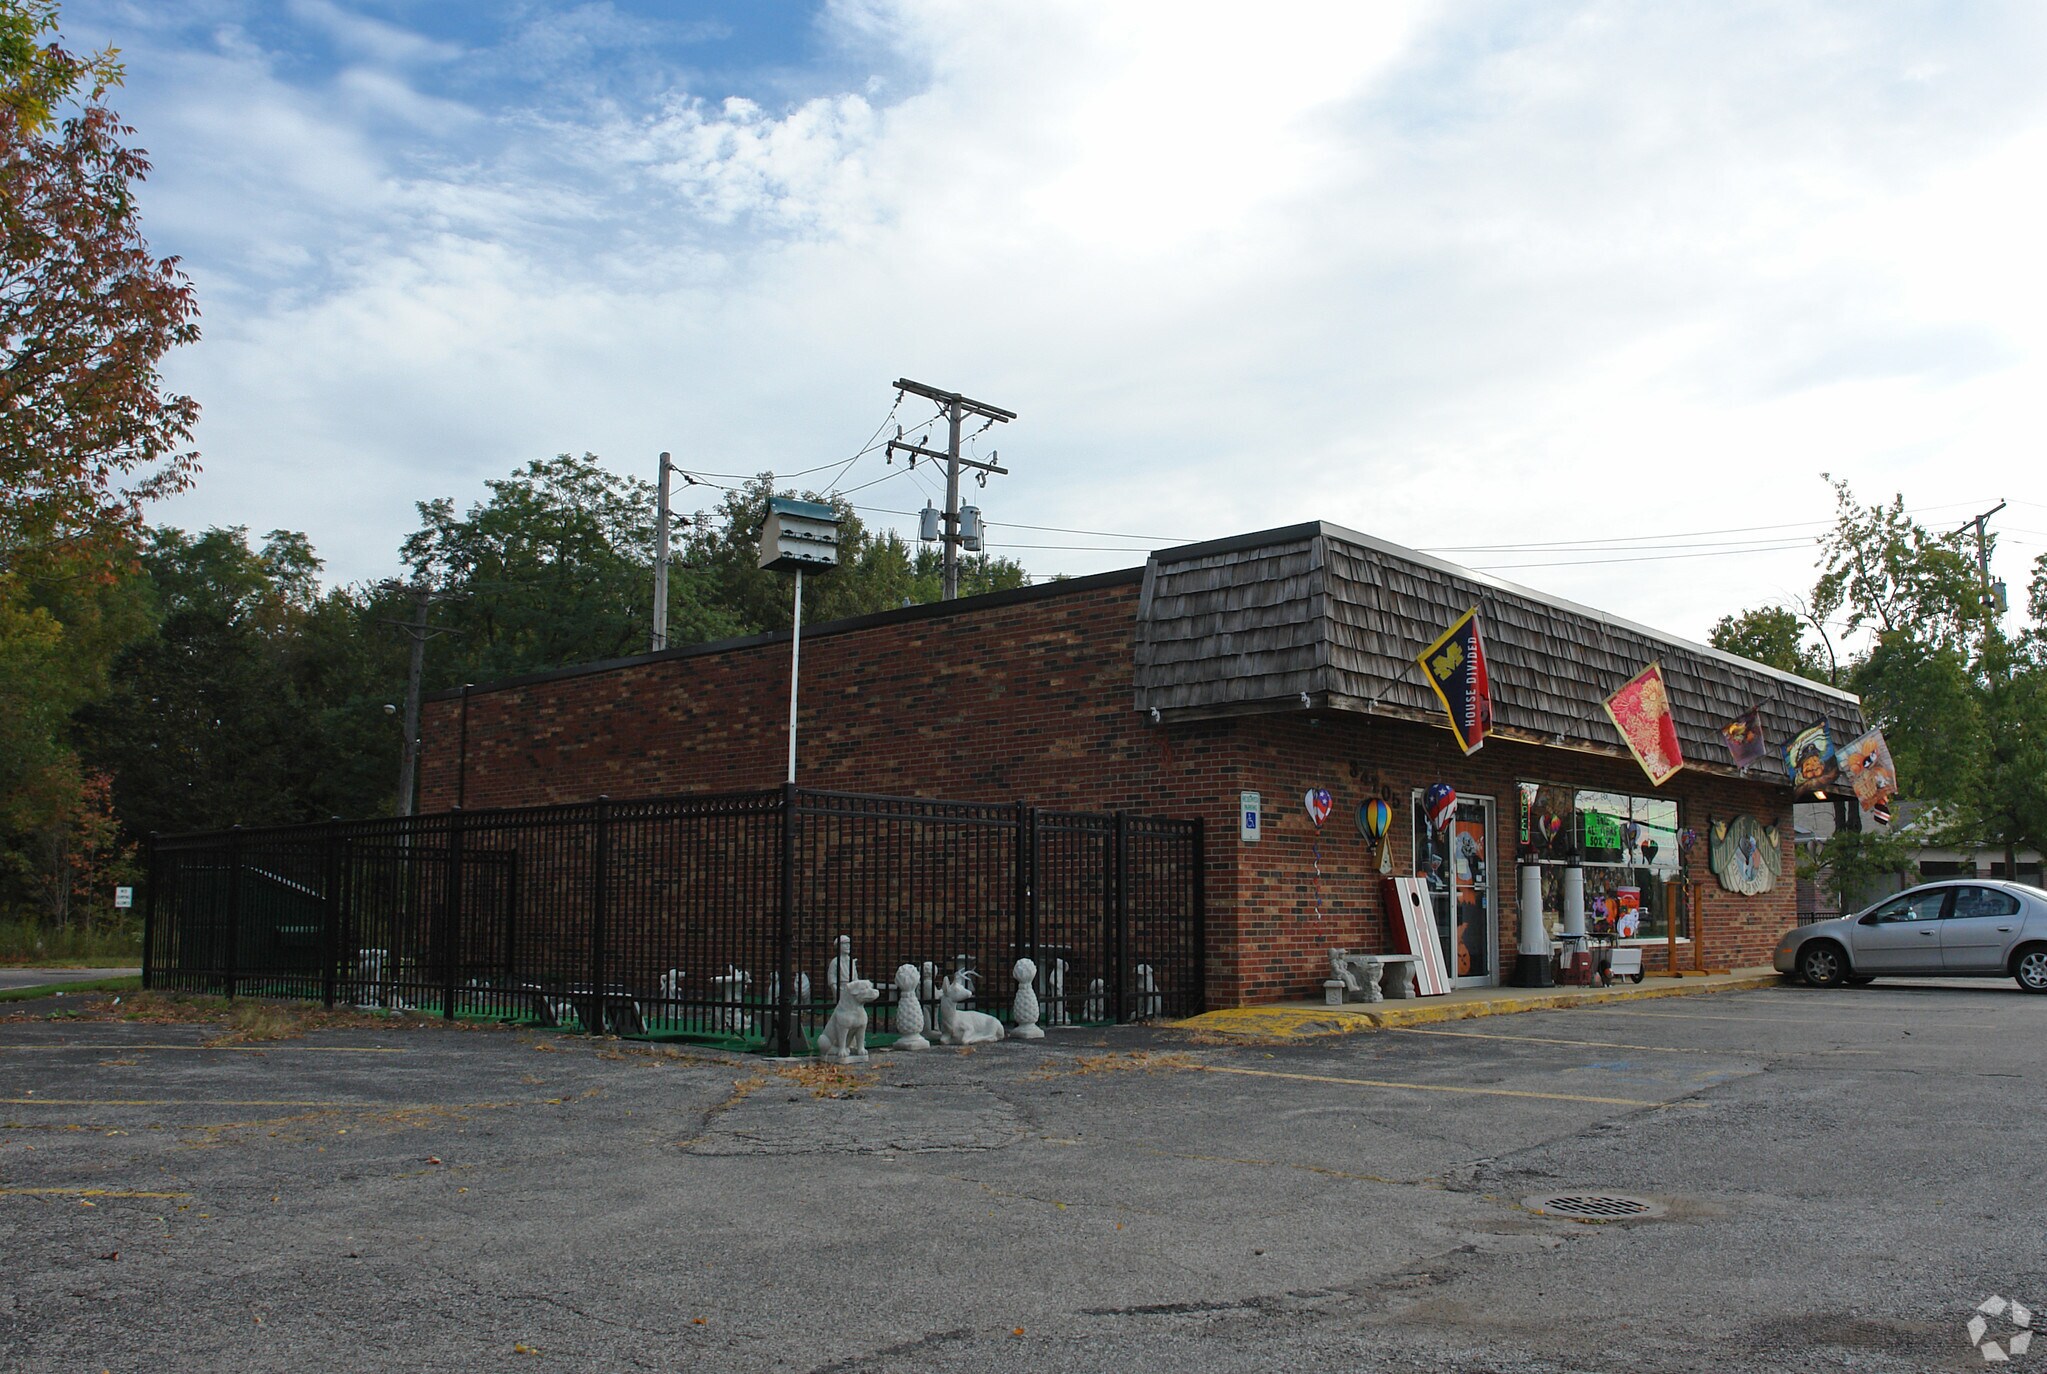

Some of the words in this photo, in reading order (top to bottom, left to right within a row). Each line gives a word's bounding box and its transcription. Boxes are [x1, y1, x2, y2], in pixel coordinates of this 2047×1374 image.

[1466, 636, 1478, 684] DIVIDED
[1464, 688, 1476, 727] HOUSE
[1521, 792, 1529, 841] OPEN
[1590, 836, 1602, 847] 50%
